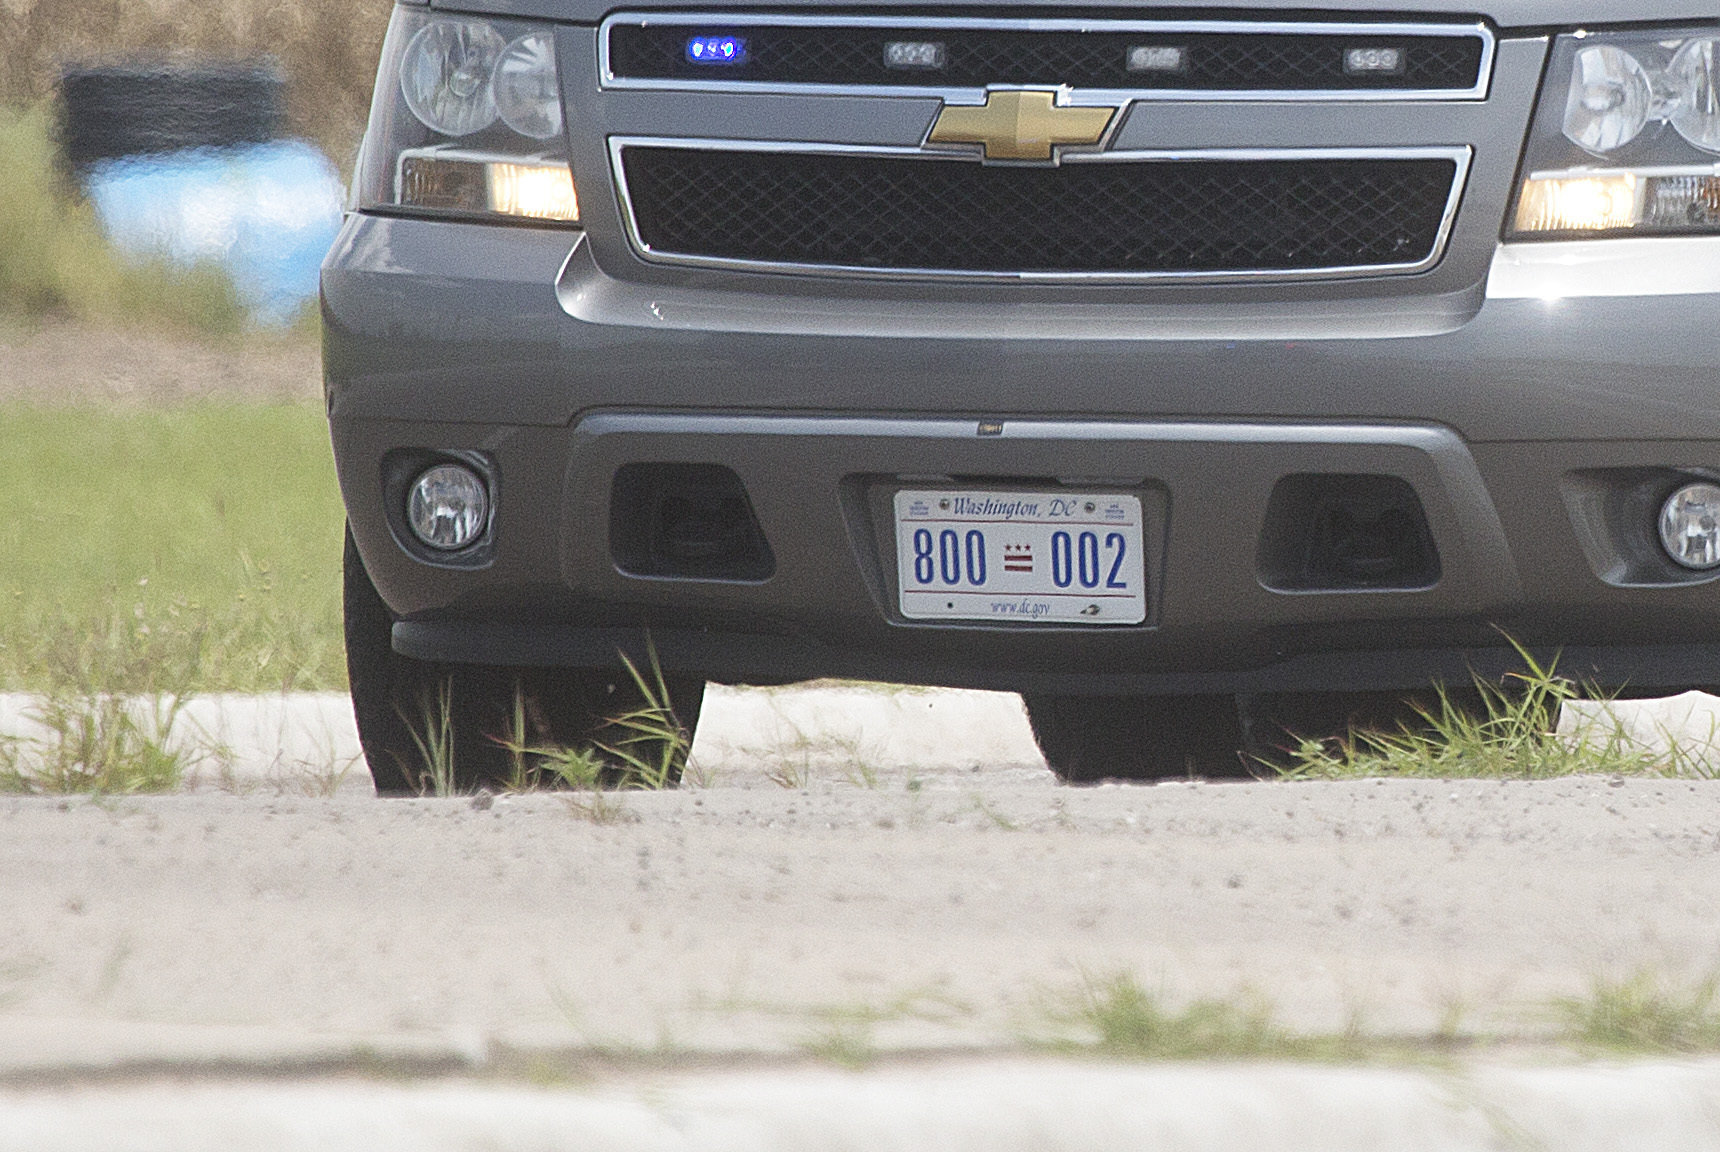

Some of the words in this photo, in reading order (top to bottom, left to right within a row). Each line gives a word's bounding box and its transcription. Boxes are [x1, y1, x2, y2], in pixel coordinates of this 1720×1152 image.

[954, 497, 1041, 520] Washington,
[1049, 498, 1077, 517] DC
[913, 528, 987, 586] 800
[1051, 530, 1127, 589] 002
[990, 598, 1050, 619] www.dc.gov
